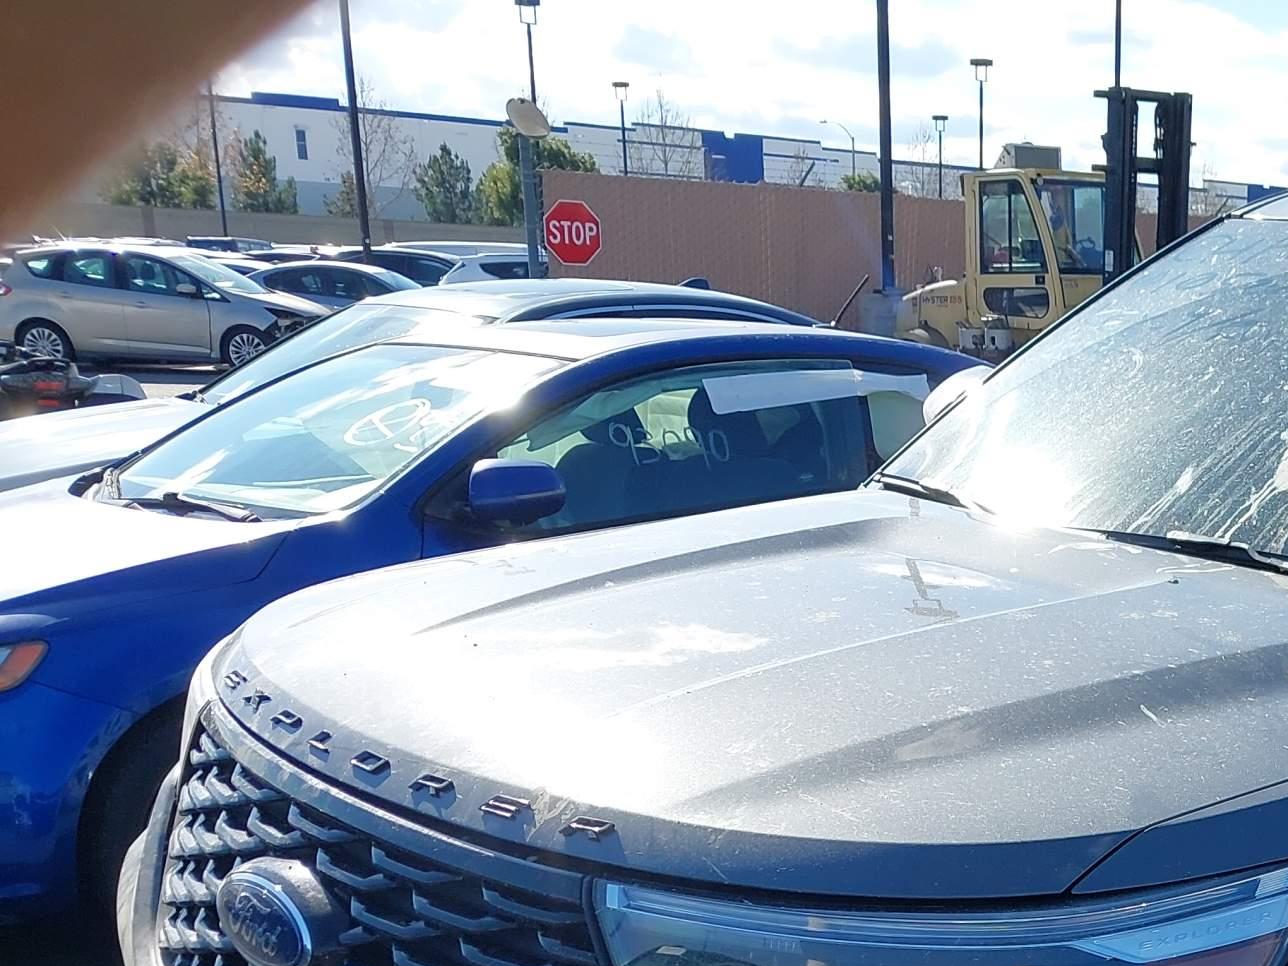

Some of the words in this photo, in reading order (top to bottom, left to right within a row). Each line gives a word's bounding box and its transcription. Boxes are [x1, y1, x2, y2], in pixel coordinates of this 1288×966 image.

[548, 219, 597, 246] STOP
[223, 669, 616, 840] EXPLORER
[227, 890, 282, 958] Ford
[1138, 911, 1273, 951] EXPLORER
